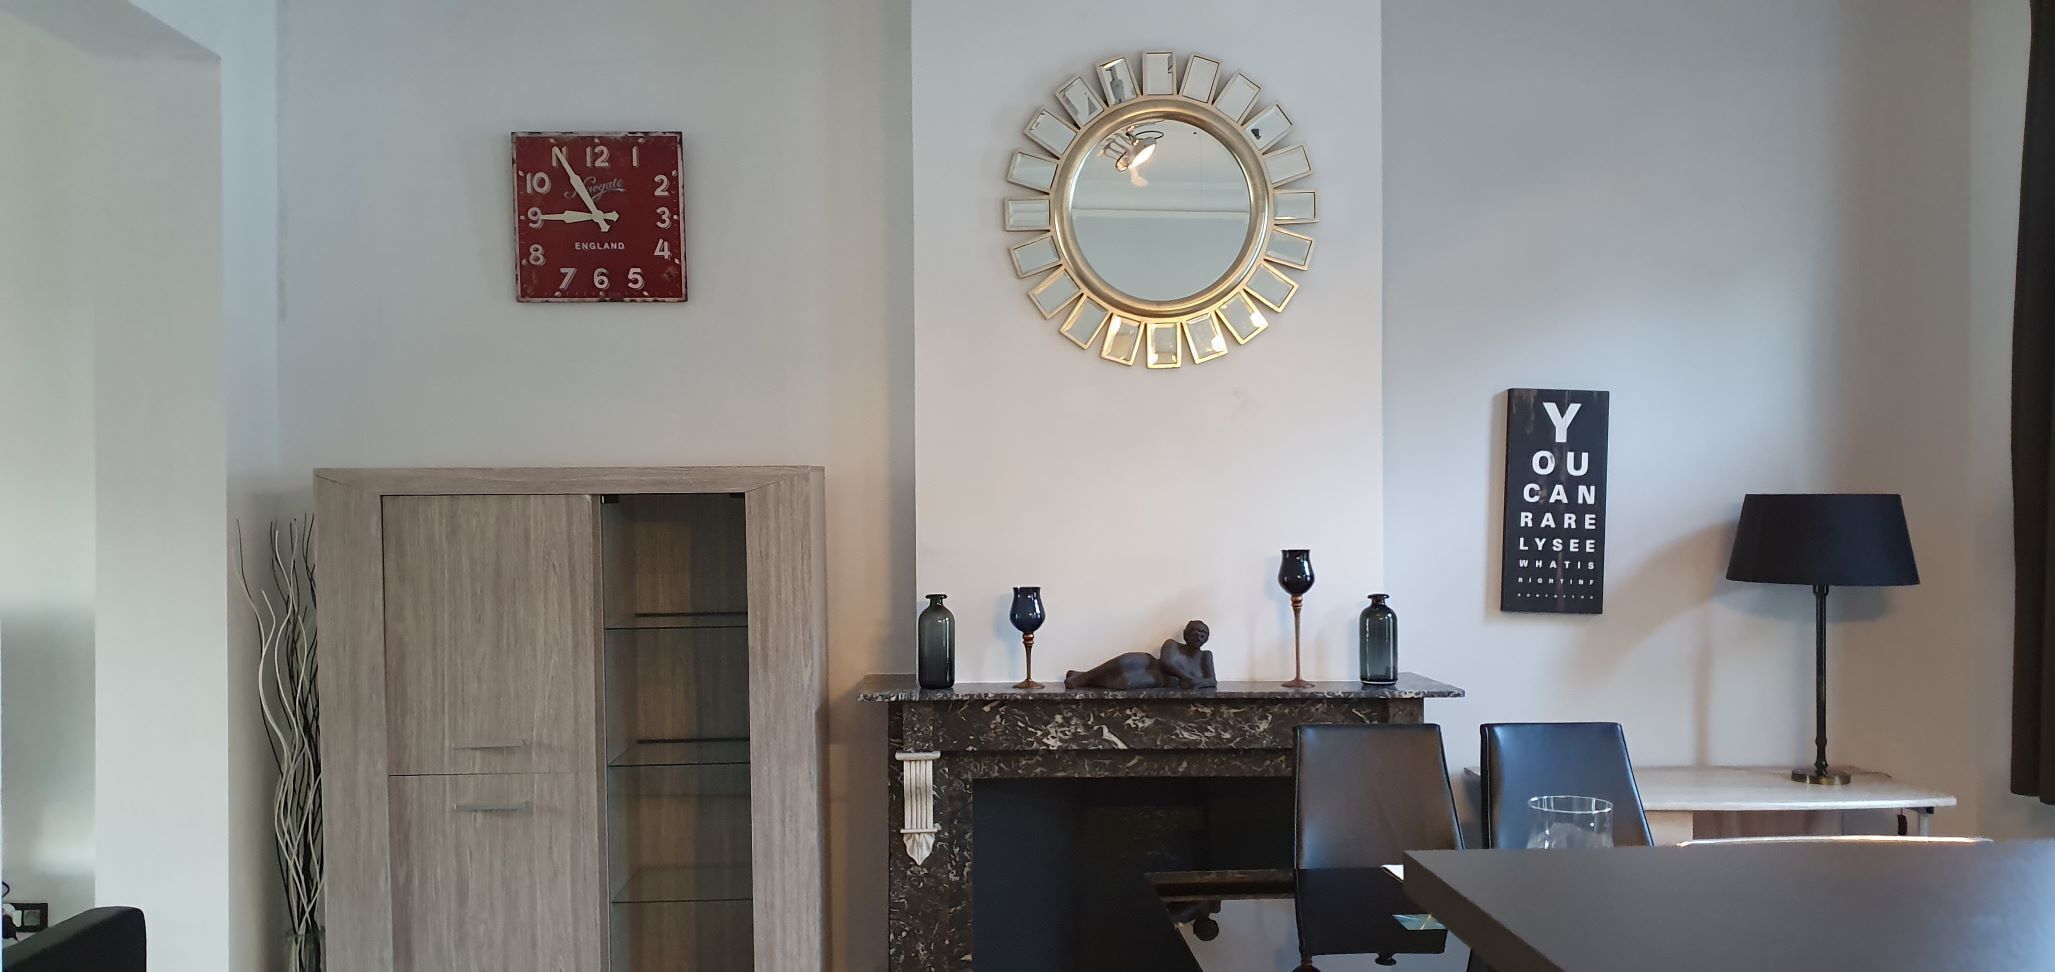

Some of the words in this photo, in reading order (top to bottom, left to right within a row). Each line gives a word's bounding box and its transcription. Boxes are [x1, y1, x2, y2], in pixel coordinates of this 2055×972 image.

[586, 145, 610, 167] 12
[632, 146, 639, 167] 1
[526, 172, 551, 195] 10
[654, 174, 670, 196] 2
[527, 207, 543, 229] 9
[656, 206, 671, 229] 3
[529, 244, 546, 266] 8
[575, 242, 625, 250] ENGLAND
[654, 239, 672, 259] 4
[559, 268, 577, 290] 7
[593, 268, 610, 290] 6
[627, 267, 644, 290] 5
[1542, 402, 1582, 443] Y
[1531, 450, 1589, 477] OU
[1523, 483, 1596, 505] CAN
[1520, 512, 1597, 530] RARE
[1519, 537, 1596, 553] LYSEE
[1518, 559, 1595, 570] WHATIS
